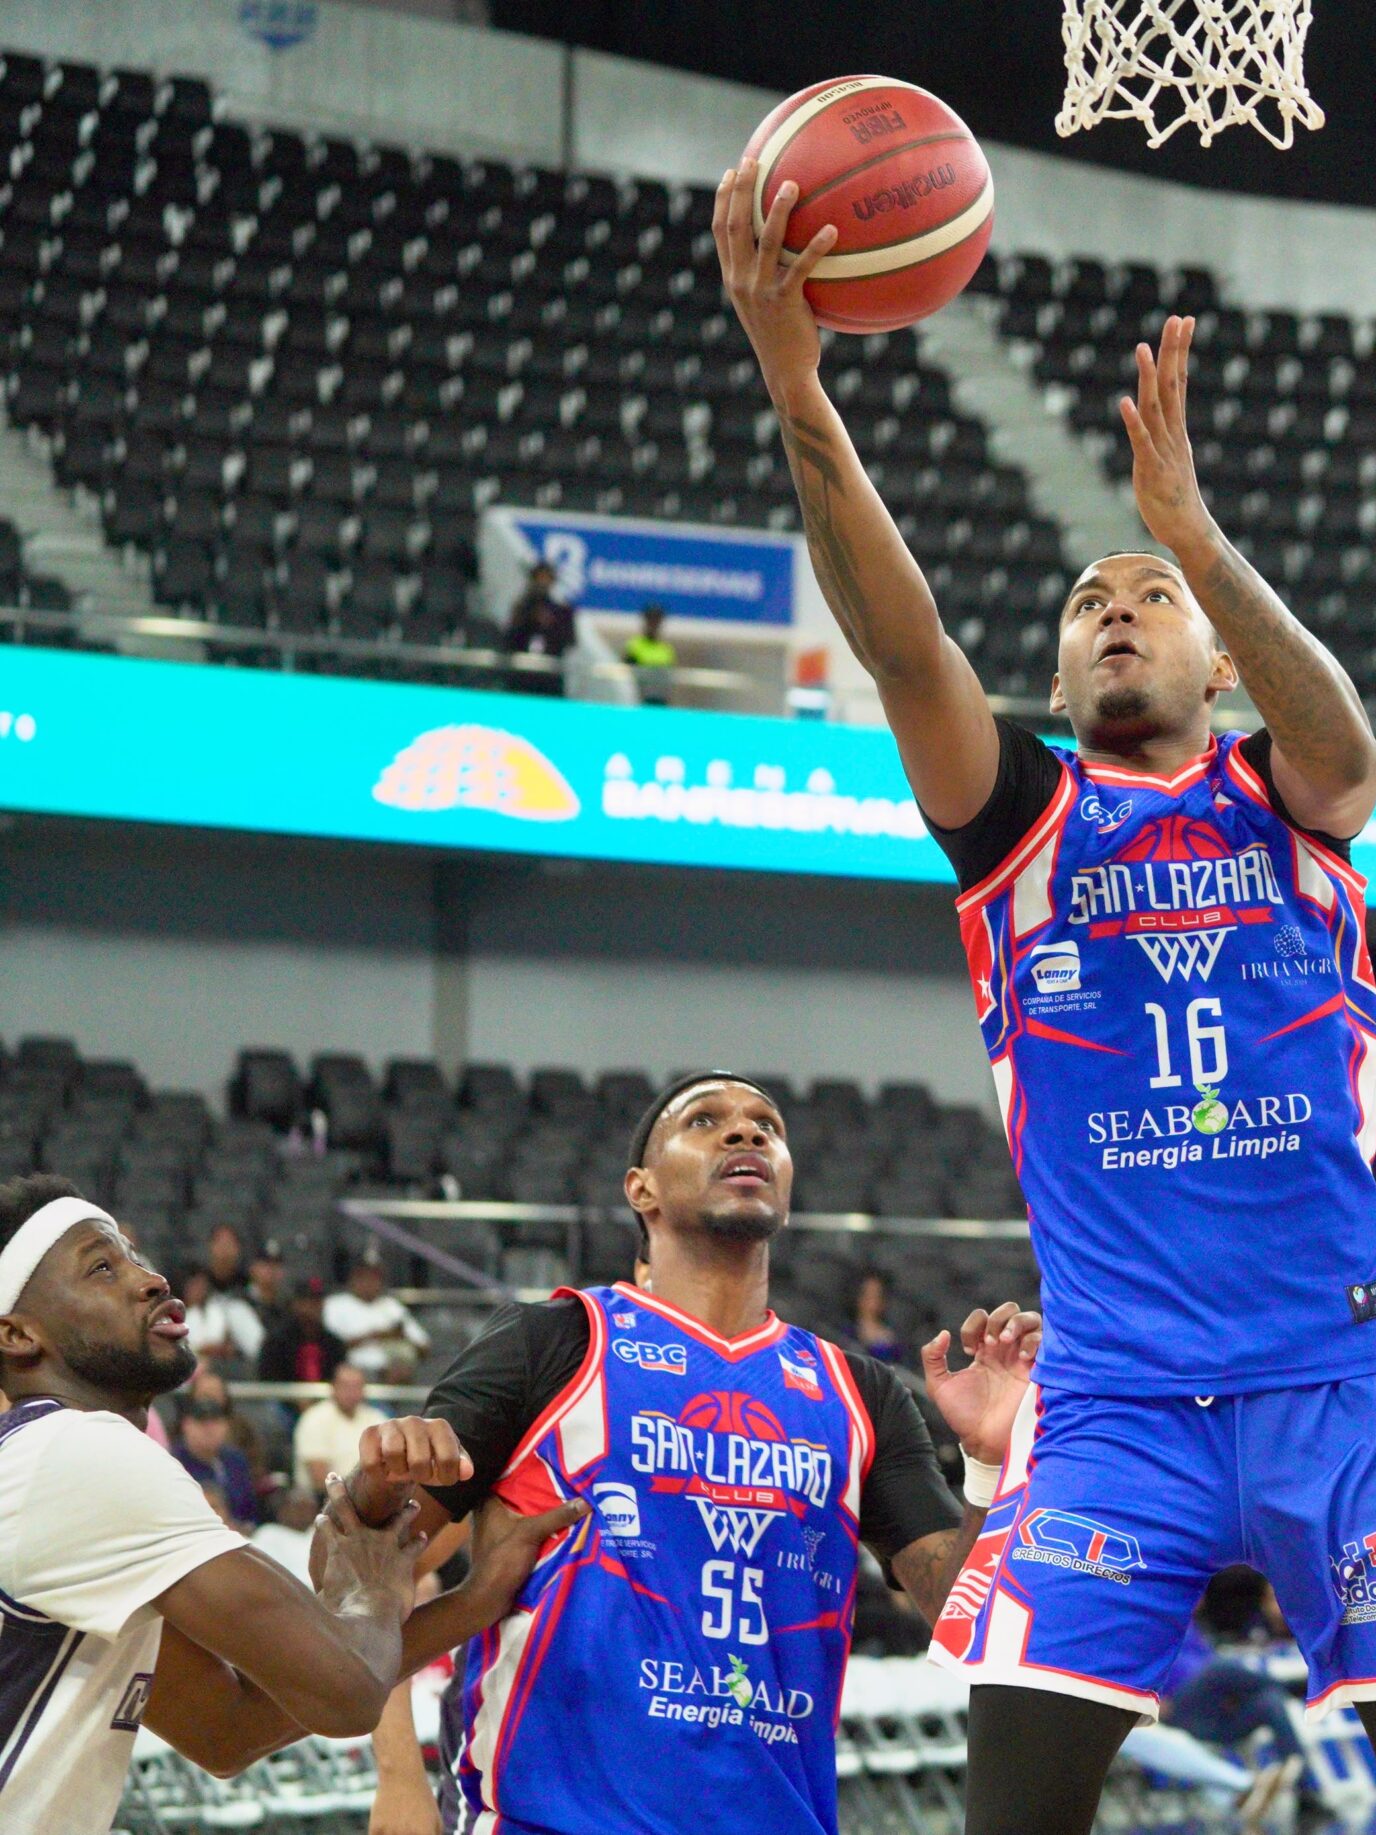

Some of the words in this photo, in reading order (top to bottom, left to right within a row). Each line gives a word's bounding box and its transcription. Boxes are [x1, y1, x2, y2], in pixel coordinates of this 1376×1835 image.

[849, 110, 907, 145] FIBA
[851, 163, 957, 221] molten
[1067, 862, 1137, 925] SAN
[1144, 849, 1285, 911] LAZARO
[1138, 911, 1222, 927] CLUB
[1036, 969, 1077, 980] Lanny
[1028, 1007, 1037, 1015] DE
[1083, 1001, 1097, 1010] SRL
[1054, 994, 1065, 1002] DE
[1066, 991, 1102, 1001] SERVICIOS
[1145, 997, 1229, 1089] 16
[1101, 1139, 1203, 1170] Energía
[1211, 1130, 1301, 1161] Limpia
[612, 1338, 687, 1368] GBC
[631, 1415, 698, 1474] SAN
[705, 1433, 832, 1509] LAZARO
[1012, 1547, 1070, 1567] CRÉDITOS
[1072, 1559, 1131, 1585] DIRECTOS
[701, 1559, 769, 1646] 55
[648, 1695, 744, 1729] Energía
[749, 1714, 799, 1745] impia
